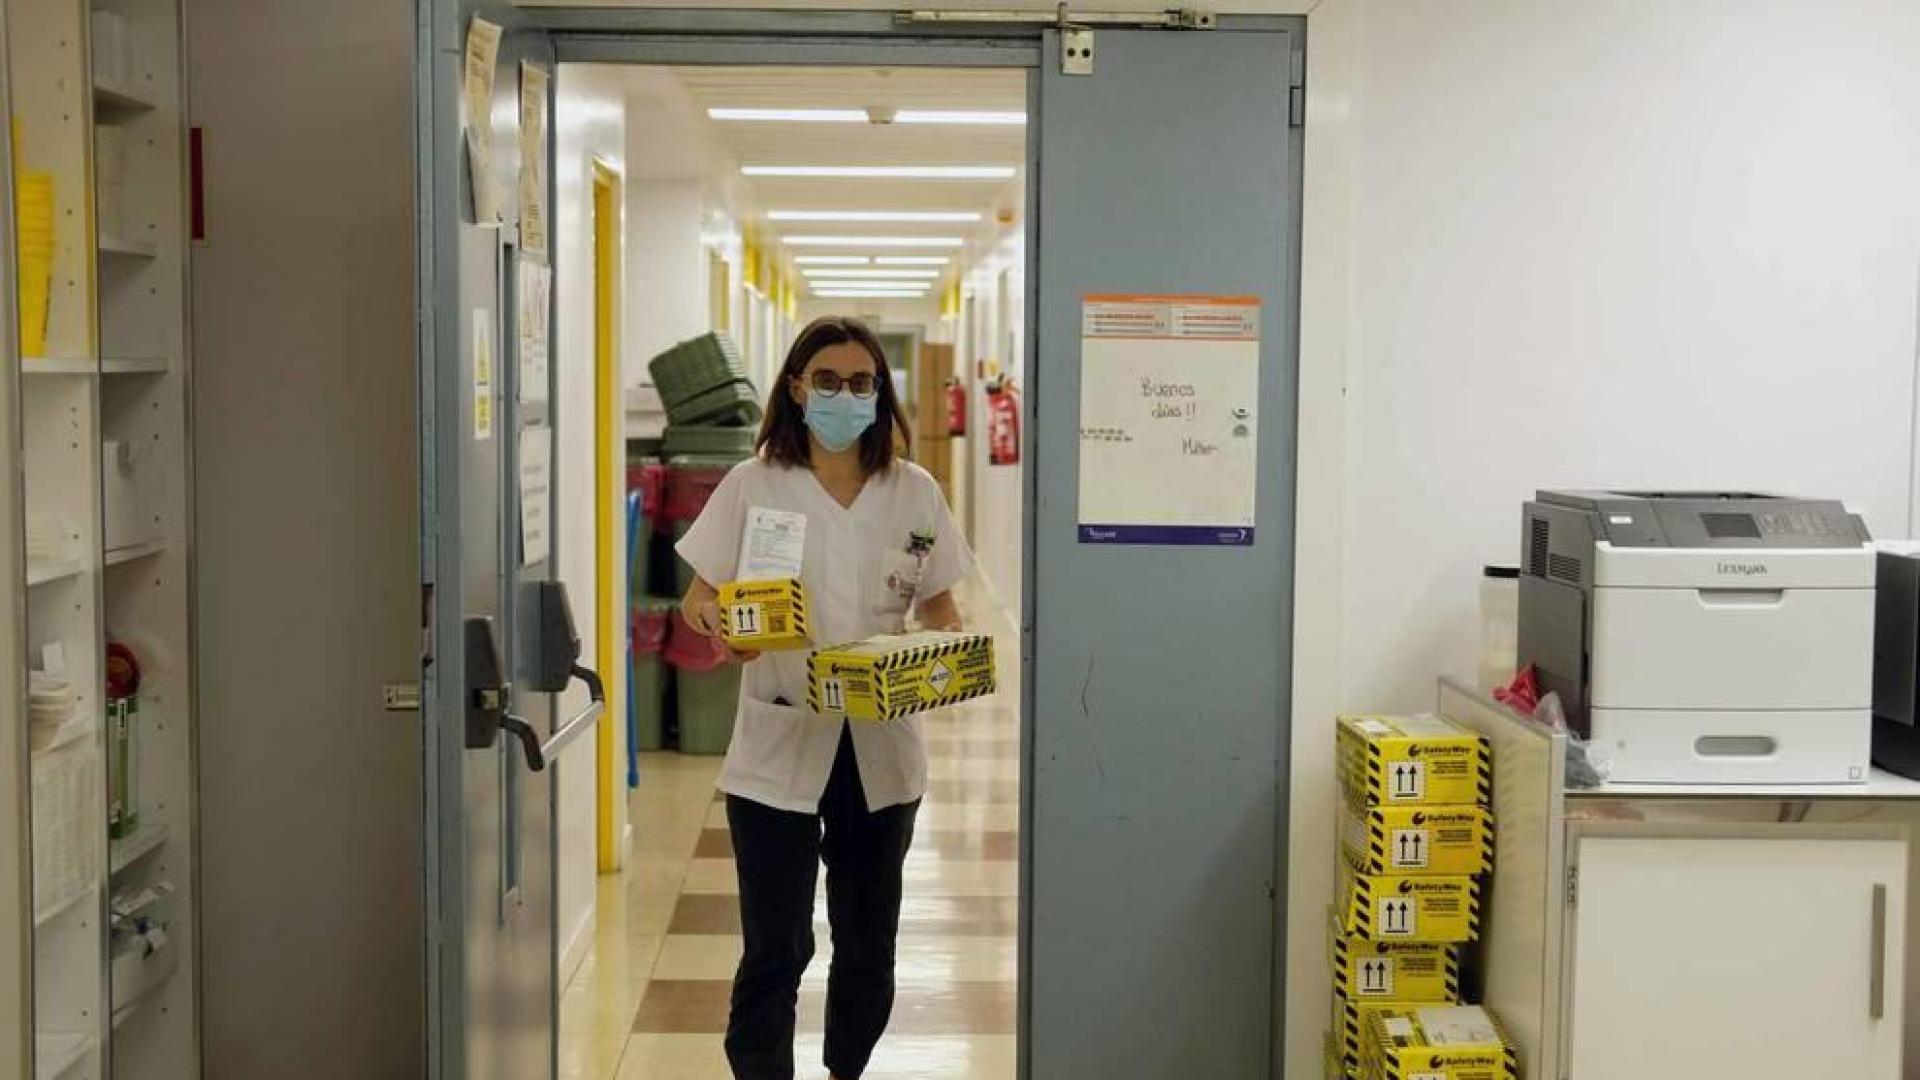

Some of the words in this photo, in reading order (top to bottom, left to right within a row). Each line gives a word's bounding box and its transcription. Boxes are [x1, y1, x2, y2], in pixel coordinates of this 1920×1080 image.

[1423, 745, 1471, 756] SafetyWay
[1427, 813, 1475, 824] SafetyWay
[1414, 882, 1463, 893] SafetyWay
[1391, 941, 1440, 953] SafetyWay
[1446, 1056, 1496, 1068] SafetyWay
